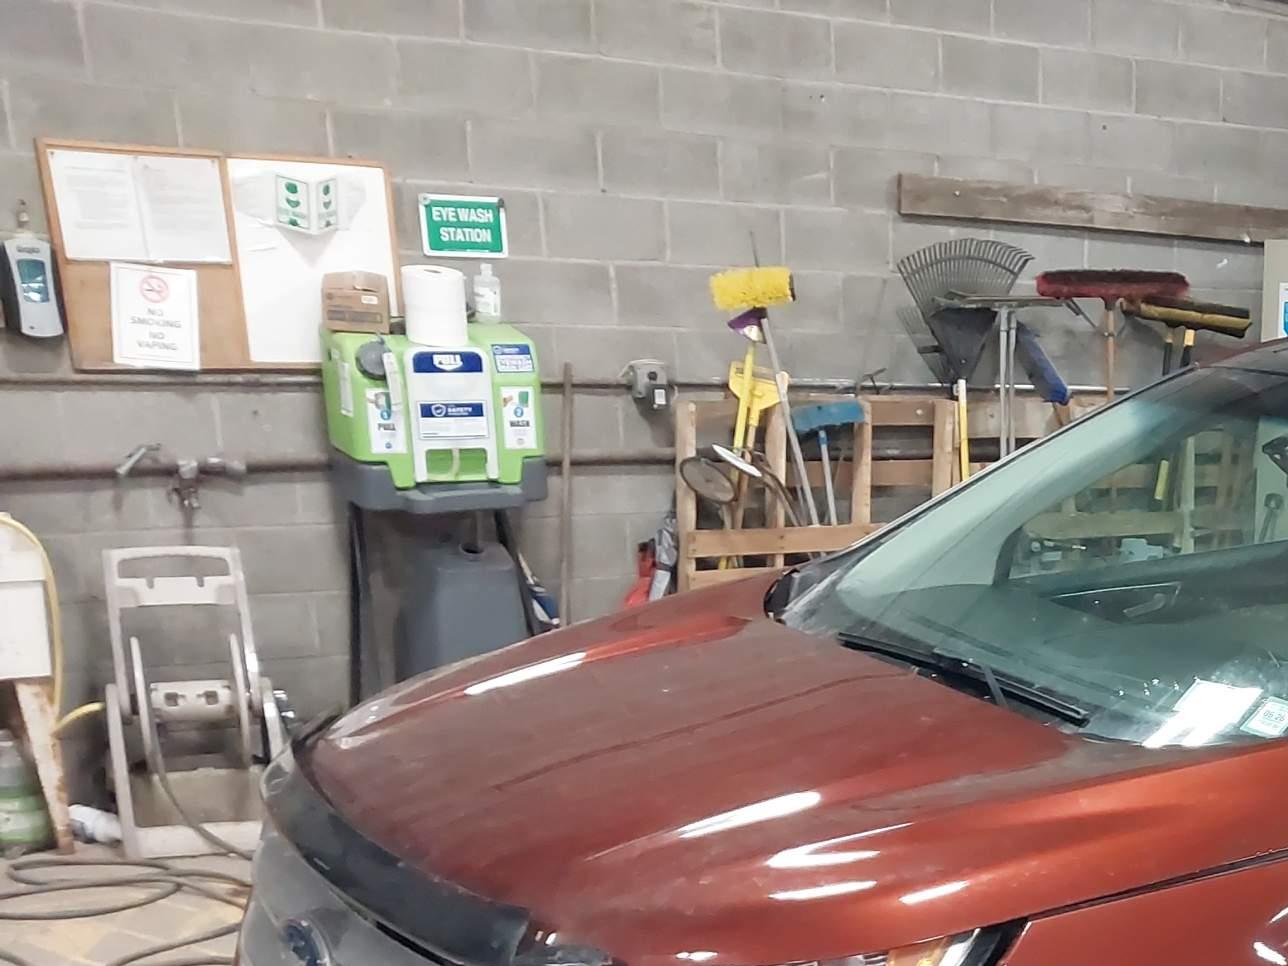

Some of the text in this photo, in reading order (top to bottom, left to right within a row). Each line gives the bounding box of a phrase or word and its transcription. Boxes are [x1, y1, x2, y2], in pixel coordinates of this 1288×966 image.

[431, 206, 494, 223] EYE WASH
[440, 227, 492, 243] STATION
[146, 307, 164, 317] NO
[129, 315, 182, 328] SMOKING
[148, 331, 165, 340] NO
[136, 340, 178, 351] VAPING
